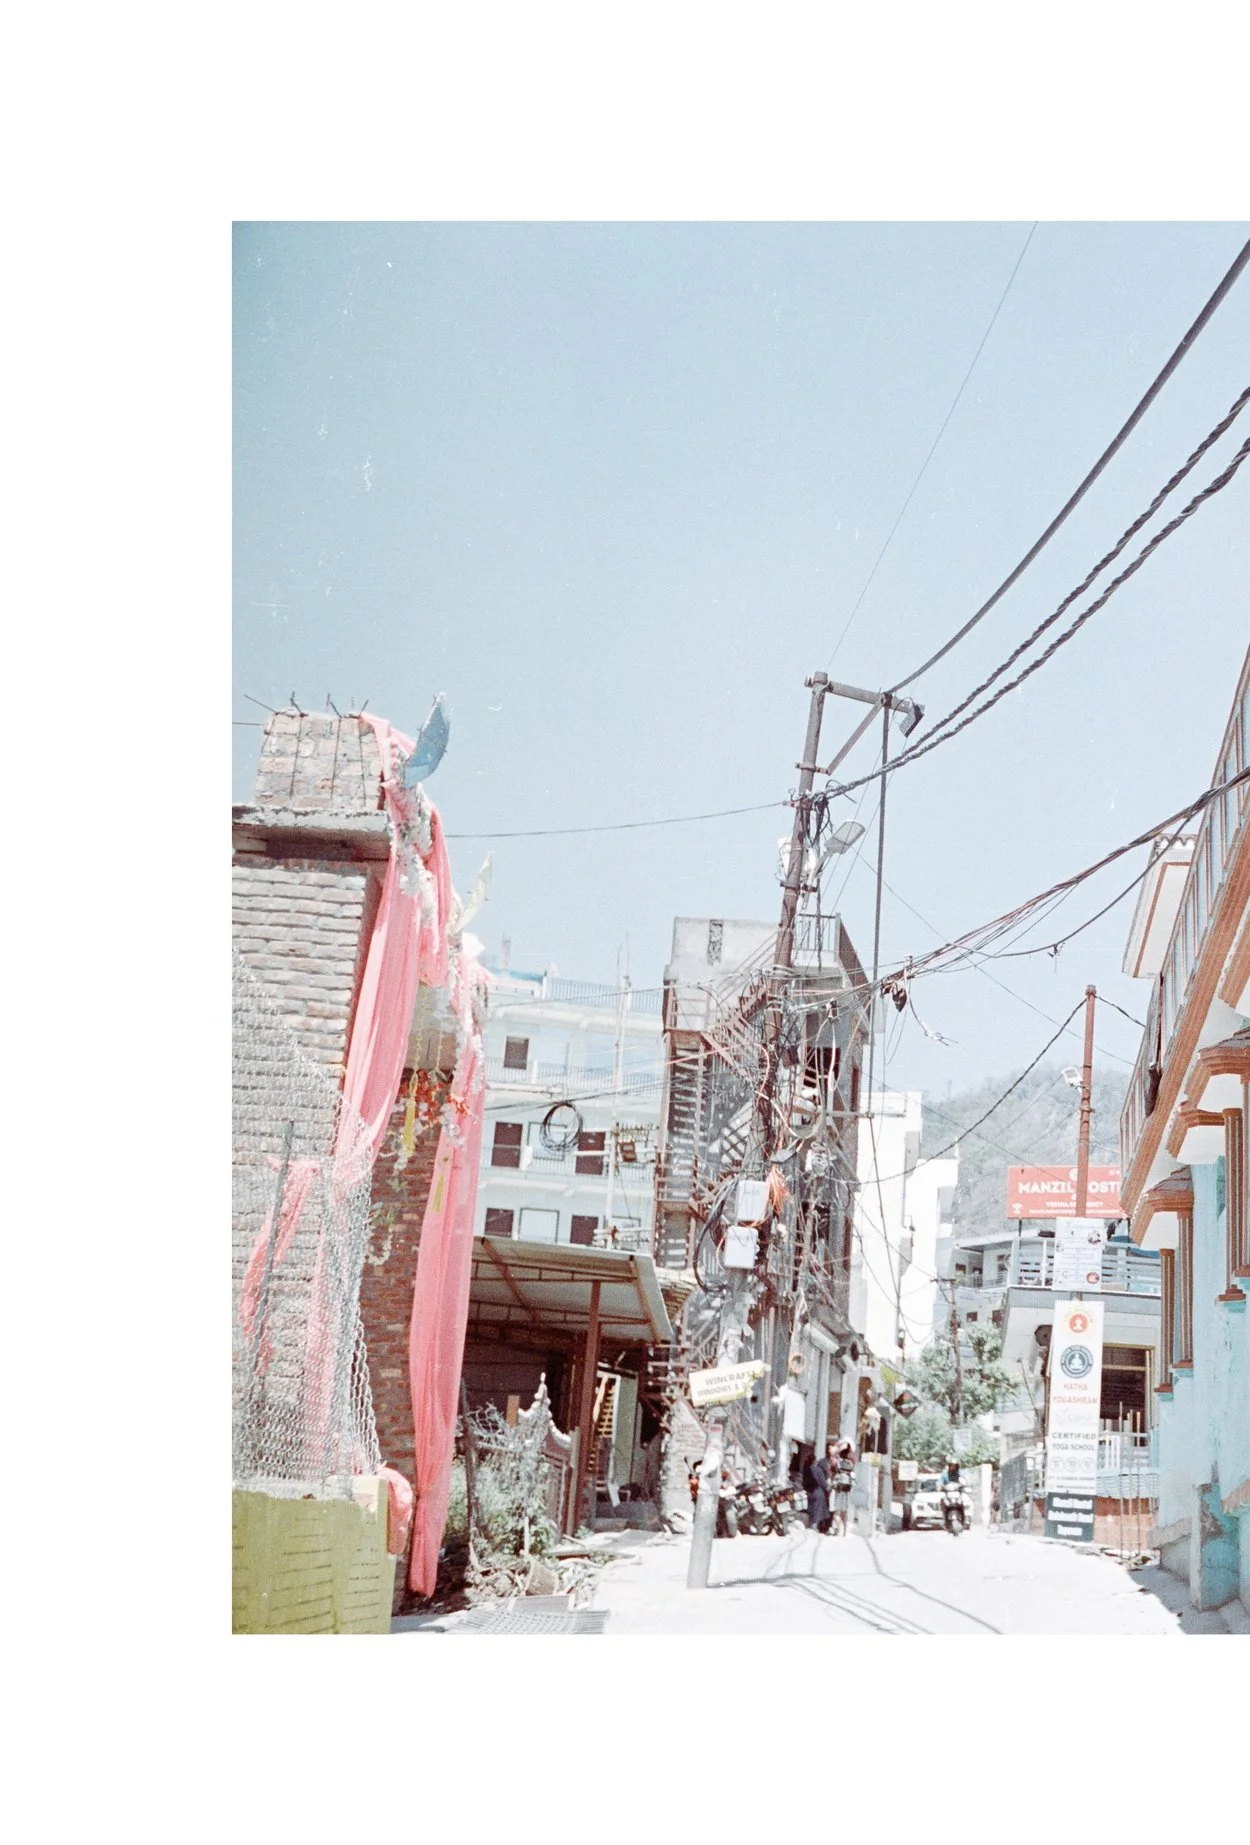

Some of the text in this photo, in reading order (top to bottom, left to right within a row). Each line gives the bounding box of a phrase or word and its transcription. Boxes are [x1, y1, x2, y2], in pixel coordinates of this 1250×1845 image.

[1018, 1181, 1121, 1194] MANZIL OST
[1052, 1432, 1097, 1440] CERTIFIED
[1052, 1443, 1096, 1451] YOGA SCHOOL
